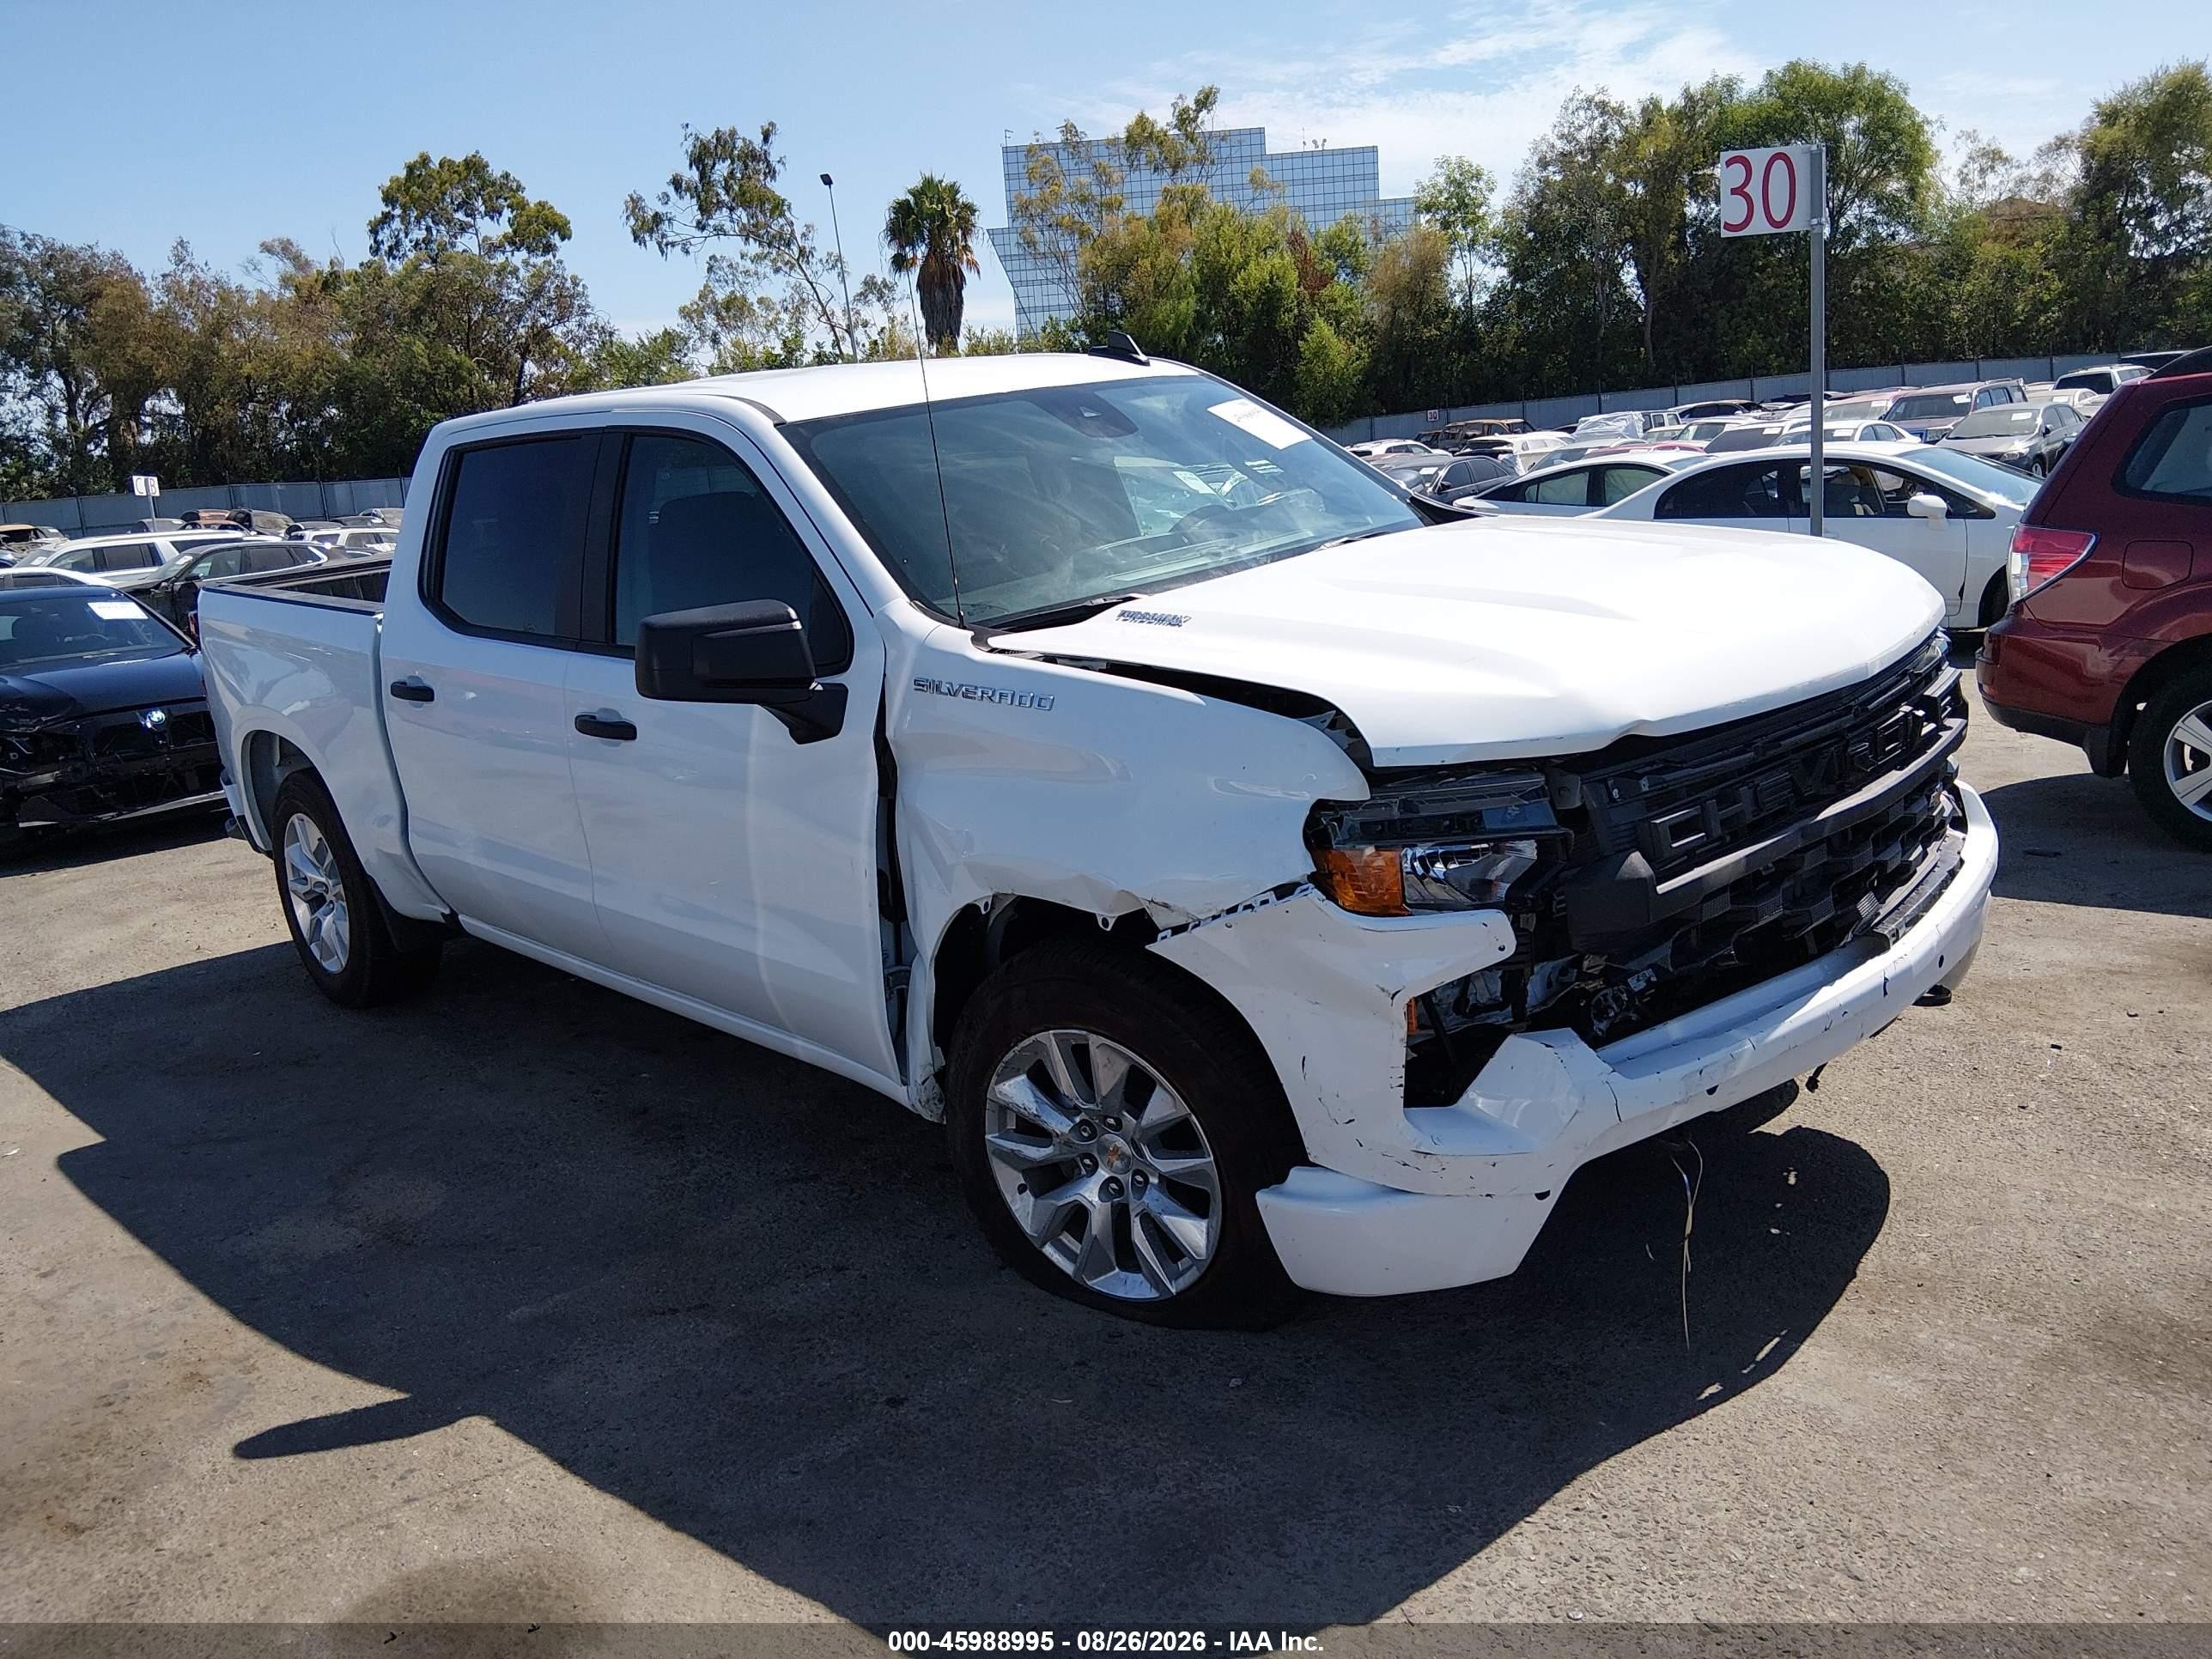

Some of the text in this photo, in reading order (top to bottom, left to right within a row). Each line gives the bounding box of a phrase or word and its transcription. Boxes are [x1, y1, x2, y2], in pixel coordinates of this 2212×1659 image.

[1723, 152, 1796, 233] 30
[1428, 411, 1437, 420] 30
[135, 477, 157, 495] C B
[913, 677, 1055, 711] SILVERADO
[1634, 672, 1960, 860] CHEVROL
